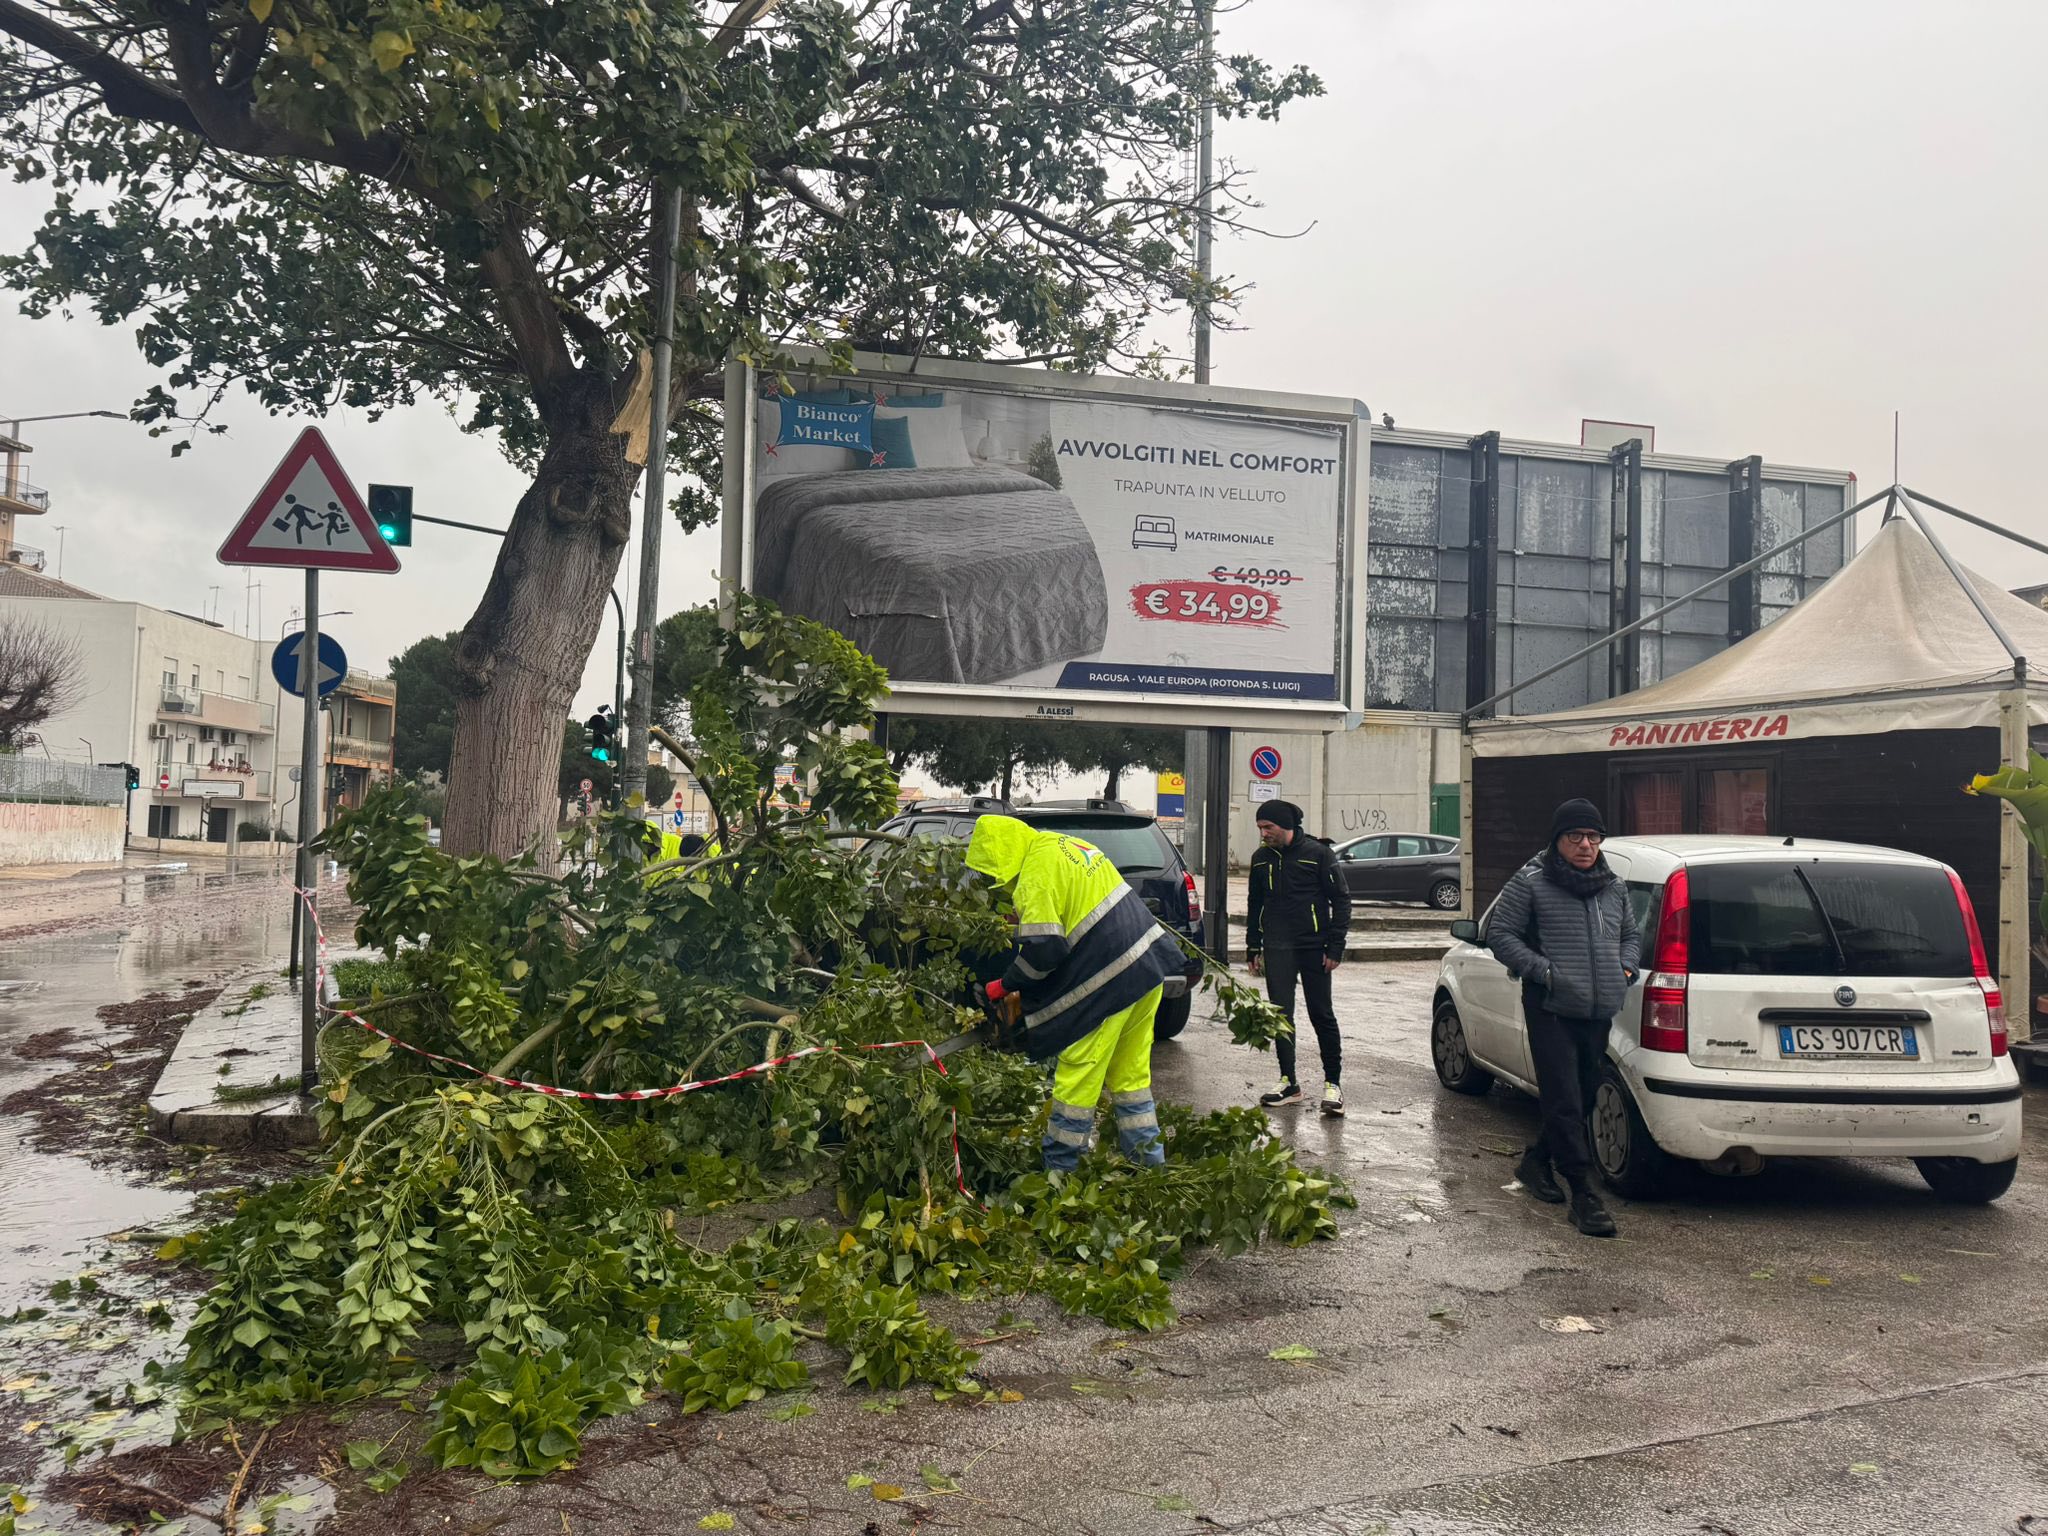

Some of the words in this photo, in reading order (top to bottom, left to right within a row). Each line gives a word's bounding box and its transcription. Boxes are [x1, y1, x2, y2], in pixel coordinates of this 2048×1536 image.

[792, 425, 861, 444] Market
[1057, 438, 1176, 464] AVVOLGITI
[1182, 449, 1224, 468] NEL
[1230, 452, 1337, 475] COMFORT
[1114, 479, 1196, 498] TRAPUNTA
[1199, 486, 1216, 499] IN
[1219, 487, 1287, 503] VELLUTO
[1184, 531, 1275, 546] MATRIMONIALE
[1234, 567, 1291, 588] 49,99
[1144, 589, 1170, 615] €
[1179, 590, 1270, 623] 34,99
[1089, 673, 1130, 683] RAGUSA
[1138, 675, 1165, 684] VIALE
[1168, 676, 1208, 686] EUROPA
[1209, 677, 1261, 689] (ROTONDA
[1262, 680, 1271, 689] S.
[1272, 680, 1301, 691] LUIGI)
[1610, 715, 1789, 748] PANINERIA
[1838, 989, 1854, 1000] FIAT
[1706, 1038, 1748, 1048] Panda
[1796, 1027, 1825, 1051] CS
[1832, 1028, 1902, 1052] 907CR
